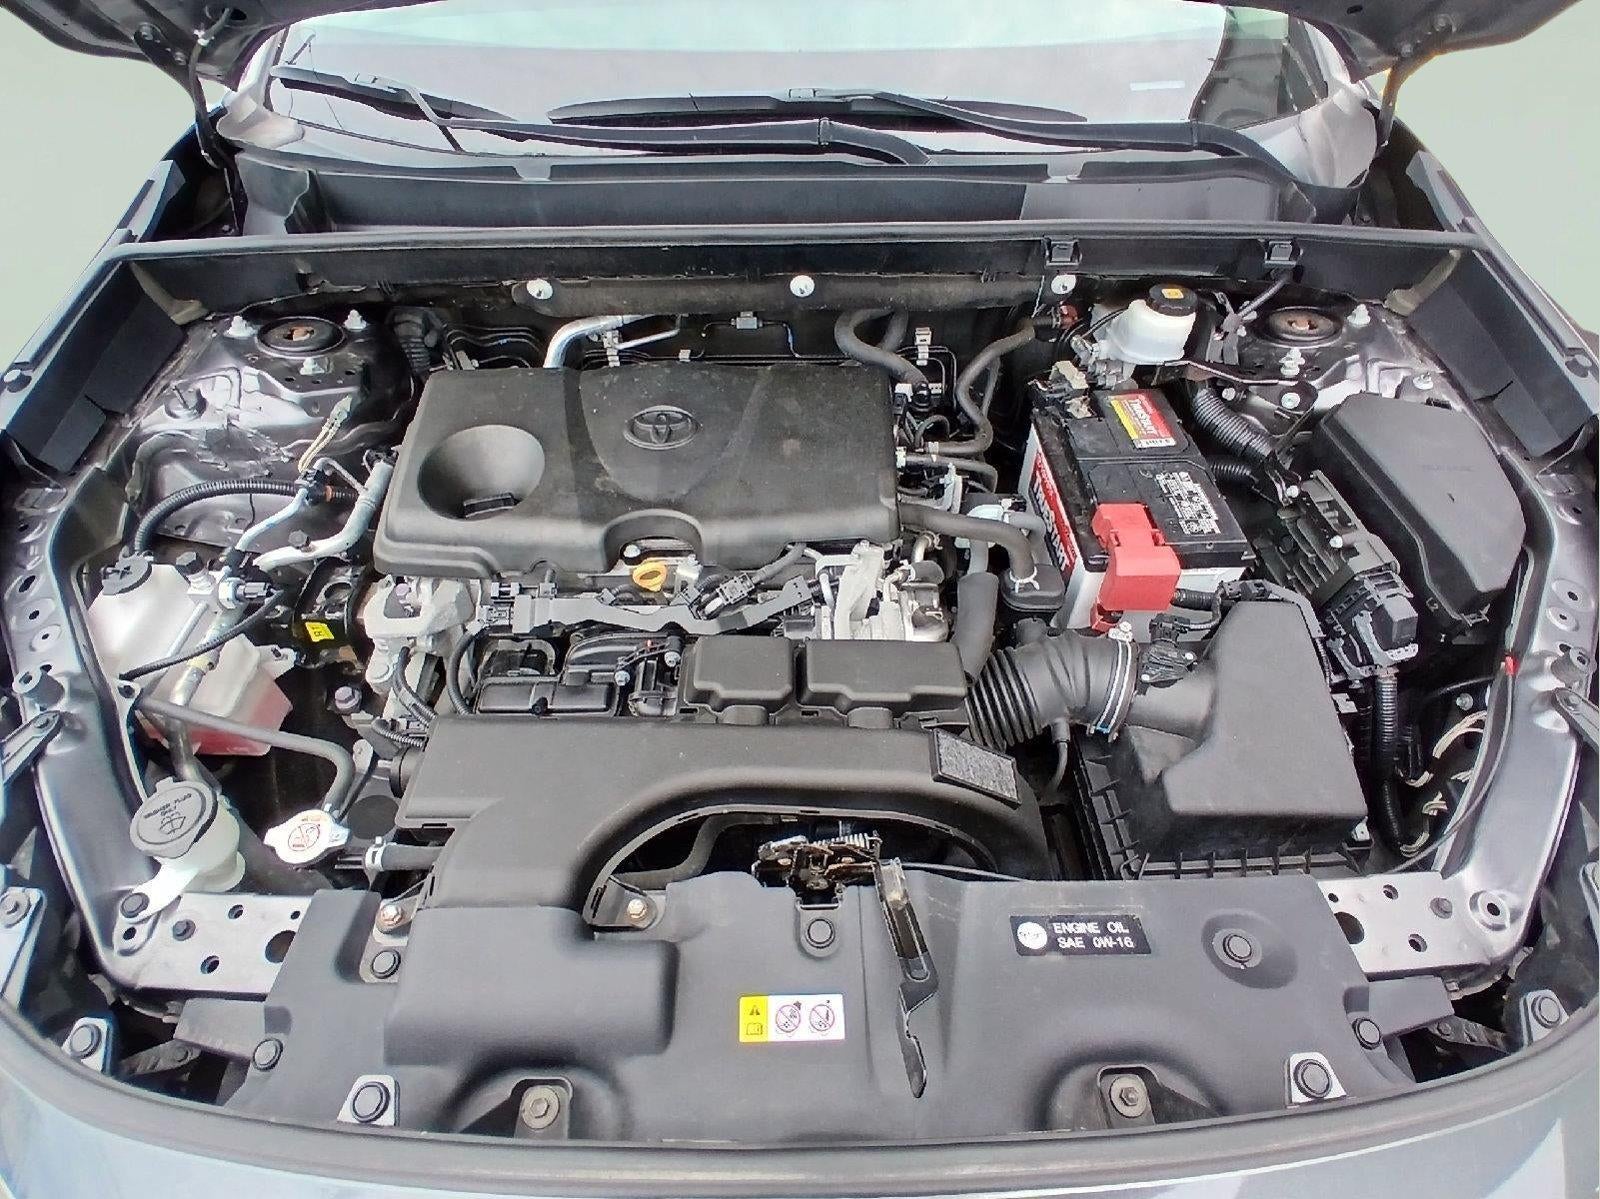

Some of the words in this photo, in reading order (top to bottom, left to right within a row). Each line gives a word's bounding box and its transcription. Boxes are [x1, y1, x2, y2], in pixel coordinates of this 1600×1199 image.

[1052, 922, 1101, 934] ENGINE
[1106, 921, 1130, 934] OIL
[1057, 936, 1086, 949] SAE
[1092, 936, 1134, 949] 0W-16
